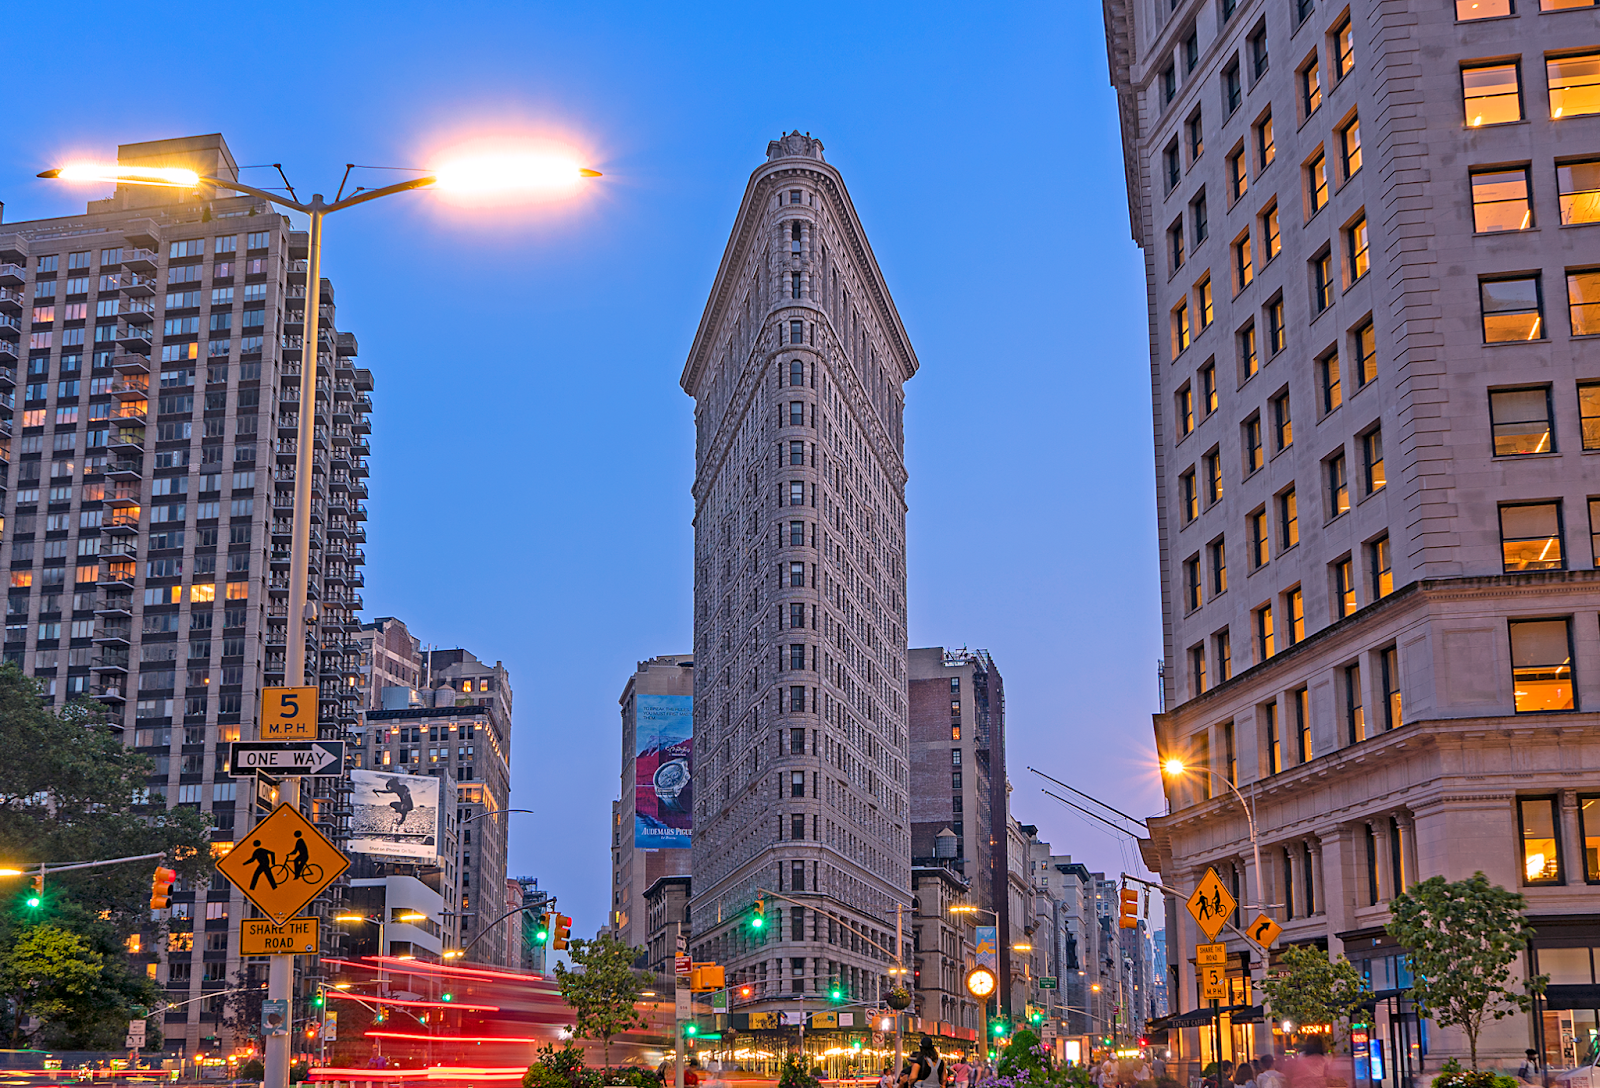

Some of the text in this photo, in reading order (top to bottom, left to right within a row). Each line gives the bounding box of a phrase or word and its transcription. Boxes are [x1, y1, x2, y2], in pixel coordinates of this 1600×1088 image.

[280, 694, 299, 719] 5
[269, 723, 308, 734] M.P.H.
[247, 752, 326, 766] ONE WAY
[641, 827, 675, 836] AUDEMARS
[249, 923, 310, 935] SHARE THE
[265, 937, 294, 949] ROAD
[1199, 945, 1223, 954] SHARE THE
[1210, 970, 1218, 985] 5
